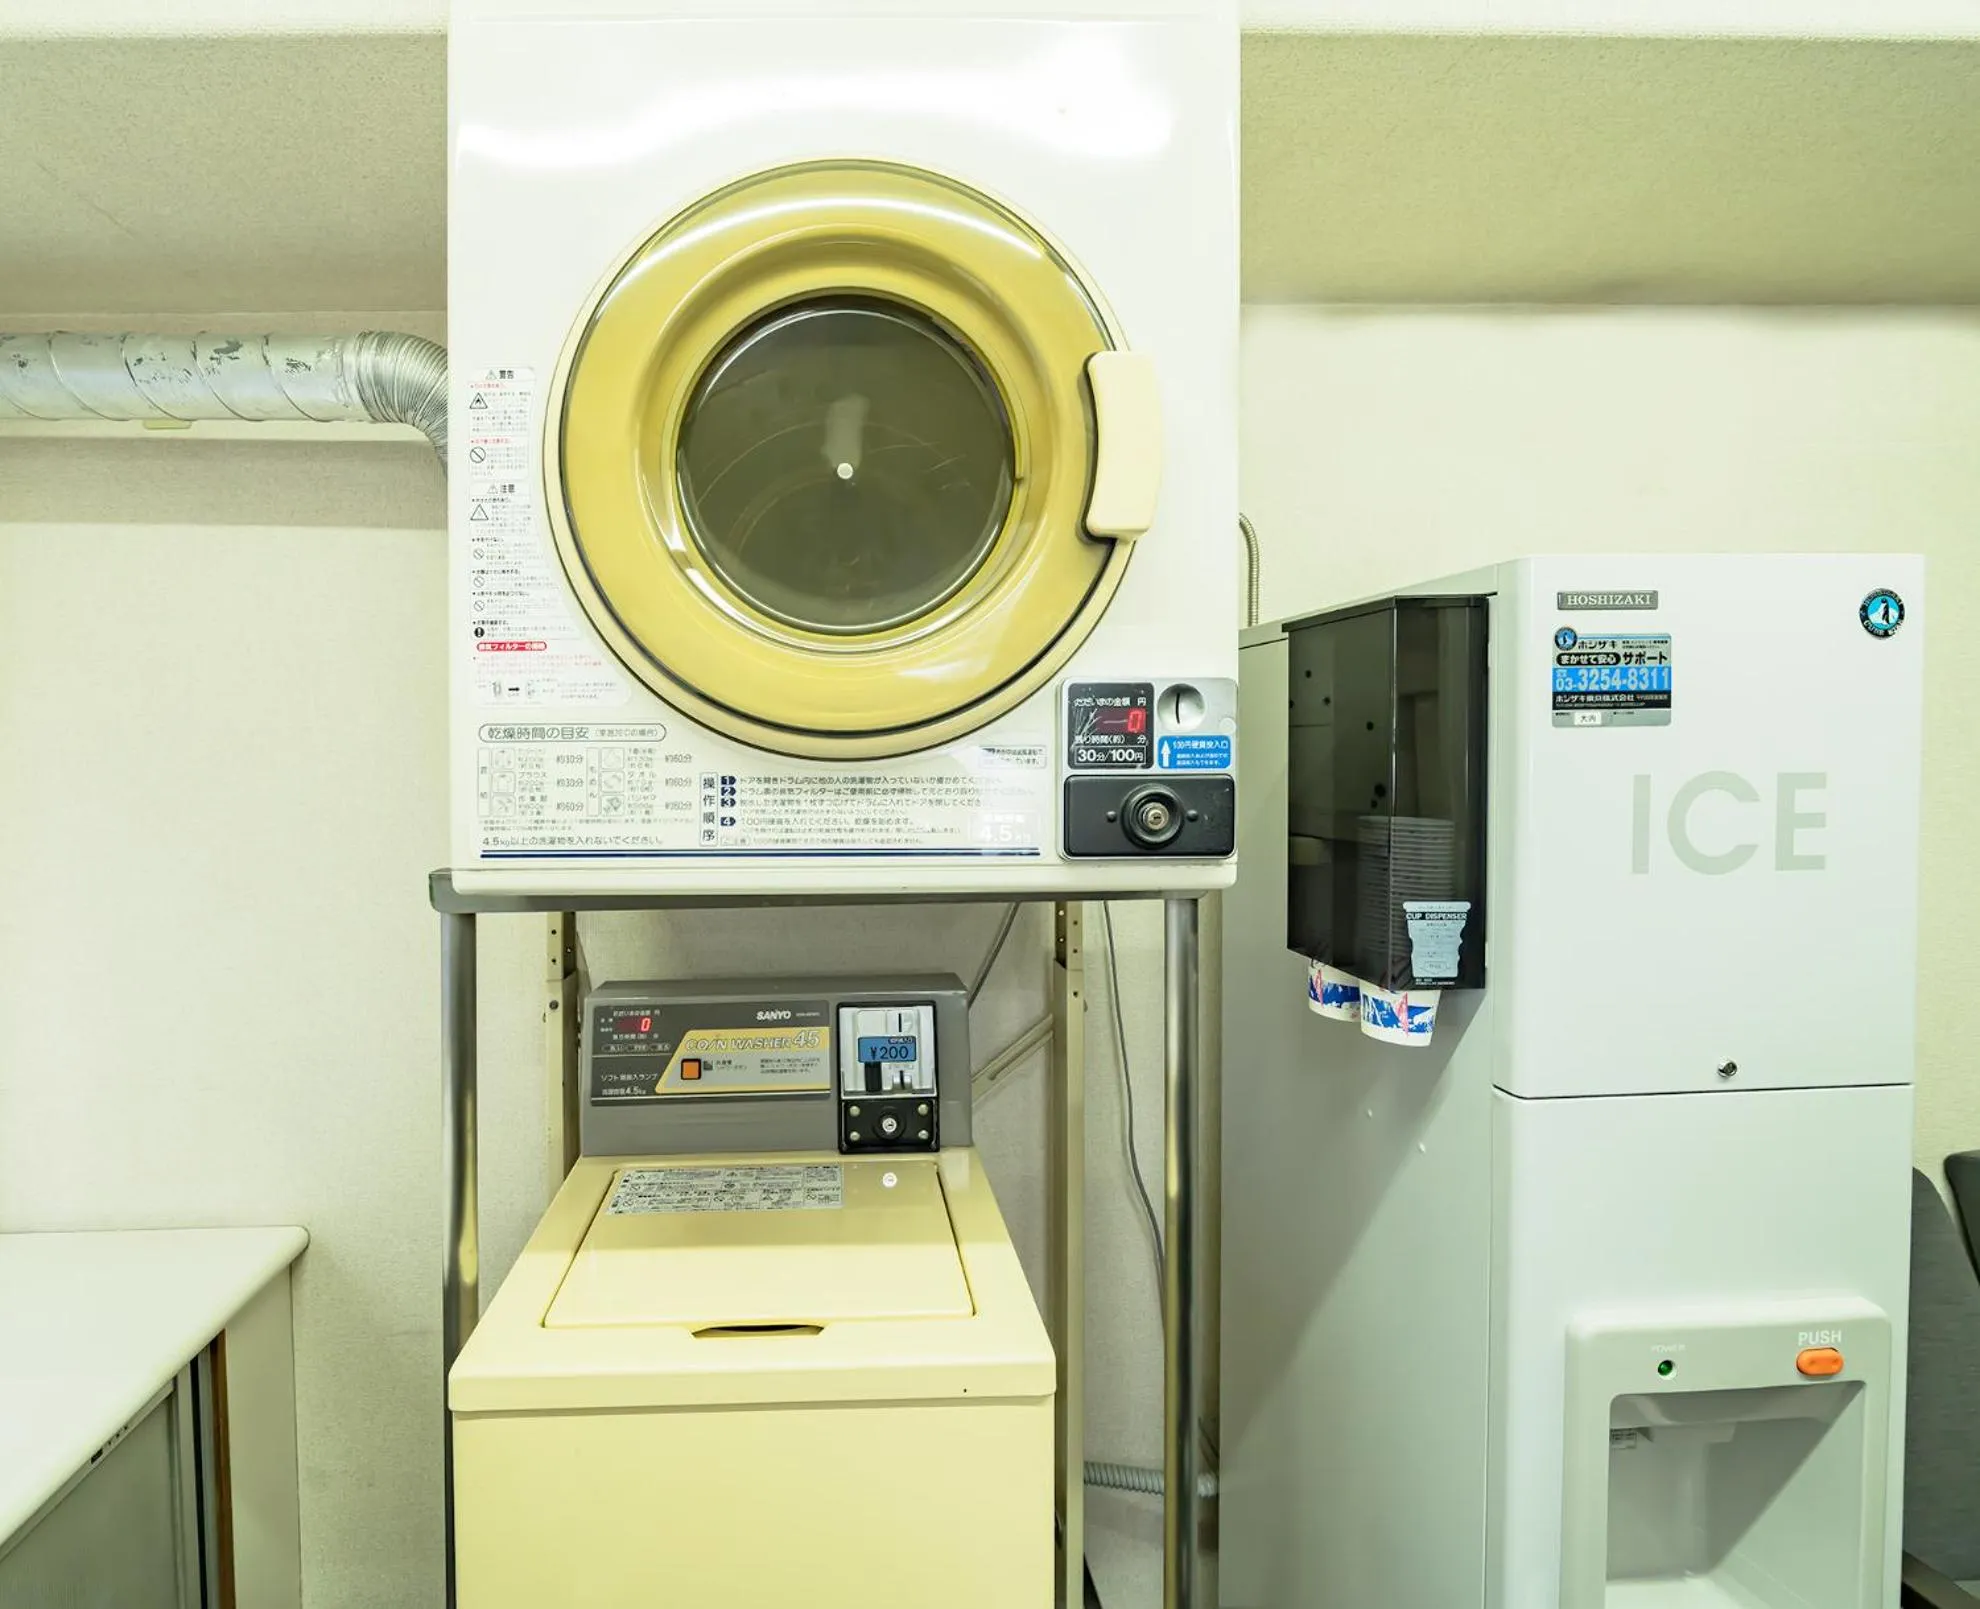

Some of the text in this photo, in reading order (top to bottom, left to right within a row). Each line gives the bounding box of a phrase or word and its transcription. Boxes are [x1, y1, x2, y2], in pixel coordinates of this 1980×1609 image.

[1567, 594, 1651, 607] HOSHIZAKI
[1622, 651, 1668, 665] サポート
[1137, 696, 1147, 707] 円
[1127, 709, 1144, 733] 0
[487, 726, 589, 740] 乾燥時間の目安
[1137, 734, 1147, 745] 分
[1077, 748, 1145, 763] 30分/100円
[702, 777, 715, 841] 操作順序
[1631, 770, 1827, 876] ICE
[1425, 912, 1467, 920] DISPENSER
[756, 1010, 791, 1021] SANYO
[641, 1017, 652, 1032] 0
[685, 1038, 727, 1051] COIN
[731, 1037, 791, 1050] WASHER
[793, 1029, 821, 1048] 45
[870, 1046, 909, 1060] ¥200
[1798, 1329, 1842, 1346] PUSH
